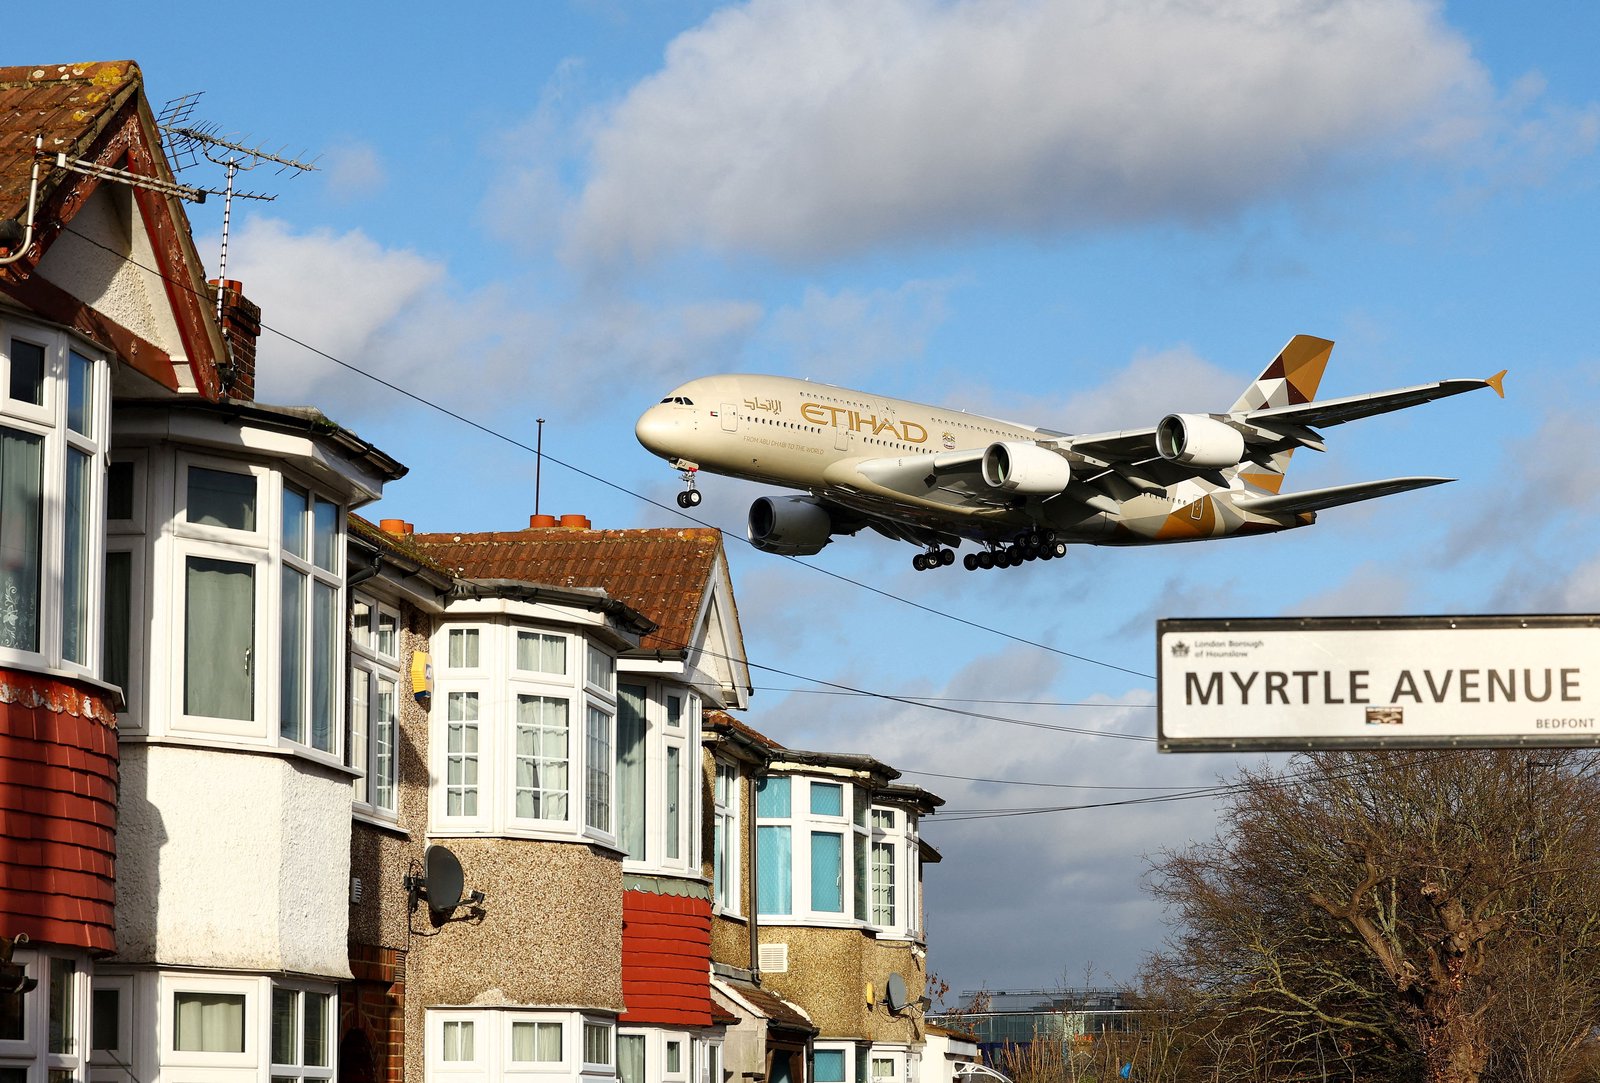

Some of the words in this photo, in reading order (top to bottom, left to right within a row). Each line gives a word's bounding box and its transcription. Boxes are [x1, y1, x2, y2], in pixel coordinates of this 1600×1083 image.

[800, 403, 928, 443] ETIHAD
[743, 435, 759, 443] FROM
[771, 440, 787, 448] DHABI
[806, 447, 825, 455] WORLD
[1194, 640, 1226, 648] London
[1228, 640, 1264, 649] Borough
[1206, 650, 1248, 658] Hounslow
[1184, 669, 1370, 706] MYRTLE
[1389, 668, 1582, 703] AVENUE
[1535, 717, 1596, 729] BEDFONT
